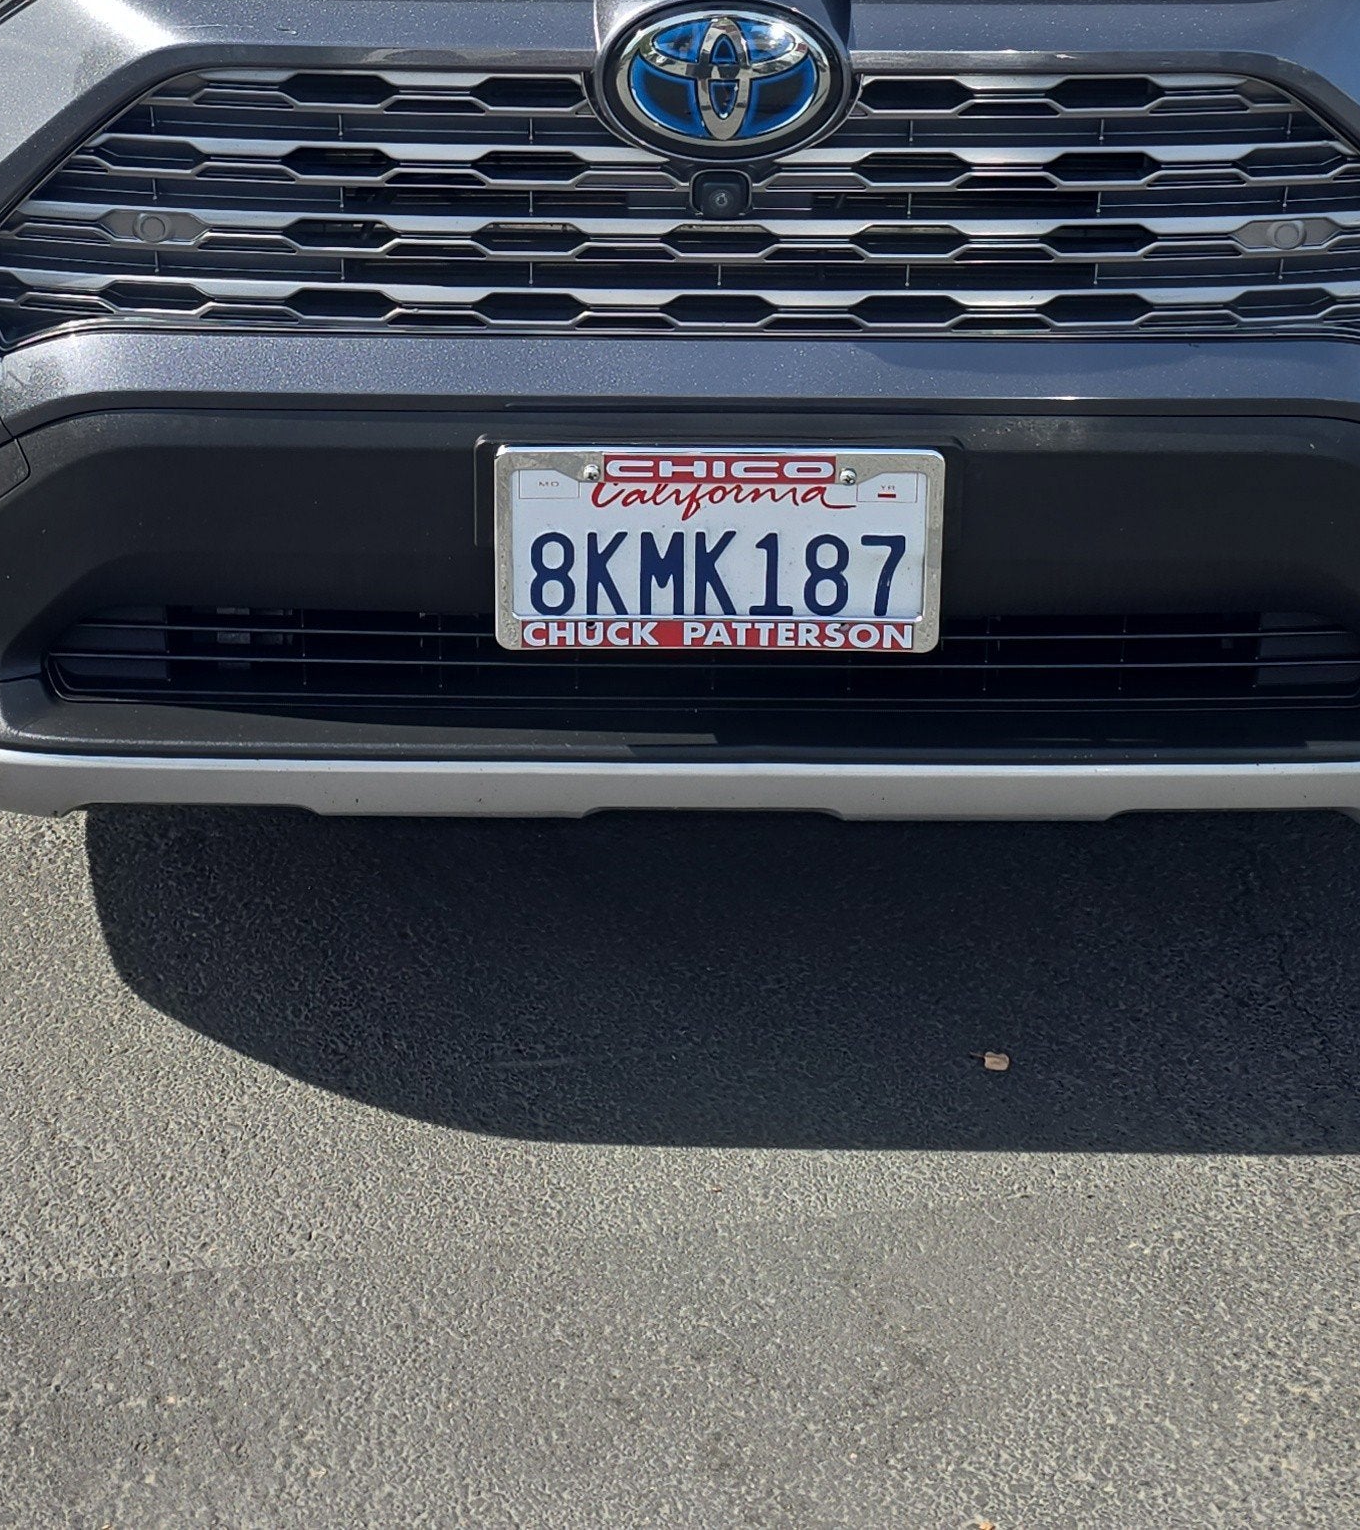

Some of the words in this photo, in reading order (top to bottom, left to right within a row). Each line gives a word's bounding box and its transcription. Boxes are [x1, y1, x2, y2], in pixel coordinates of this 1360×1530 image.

[606, 460, 834, 478] CHICO
[592, 482, 856, 521] California
[530, 531, 906, 617] 8KMK187
[523, 621, 659, 647] CHUCK
[683, 621, 914, 648] PATTERSON
